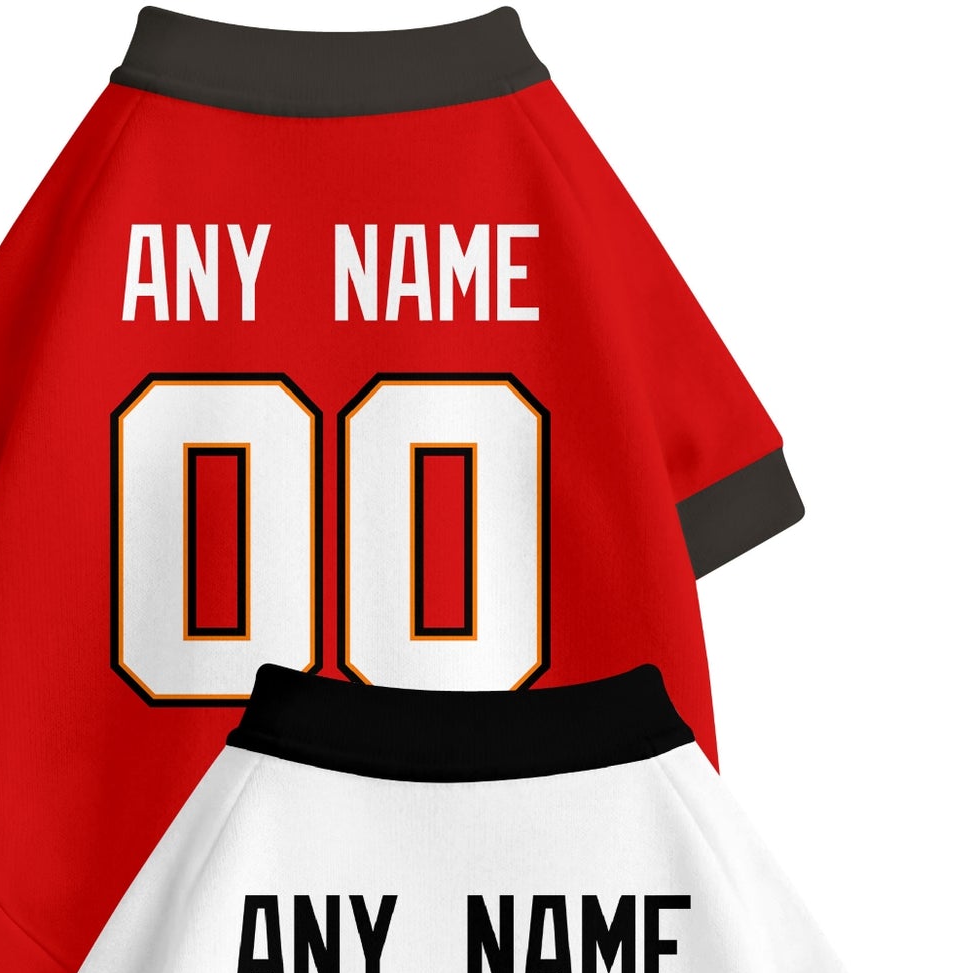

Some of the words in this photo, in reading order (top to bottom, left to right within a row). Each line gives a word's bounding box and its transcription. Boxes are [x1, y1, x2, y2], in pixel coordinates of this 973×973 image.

[122, 225, 272, 321] ANY
[334, 225, 540, 321] NAME
[110, 373, 551, 707] 00
